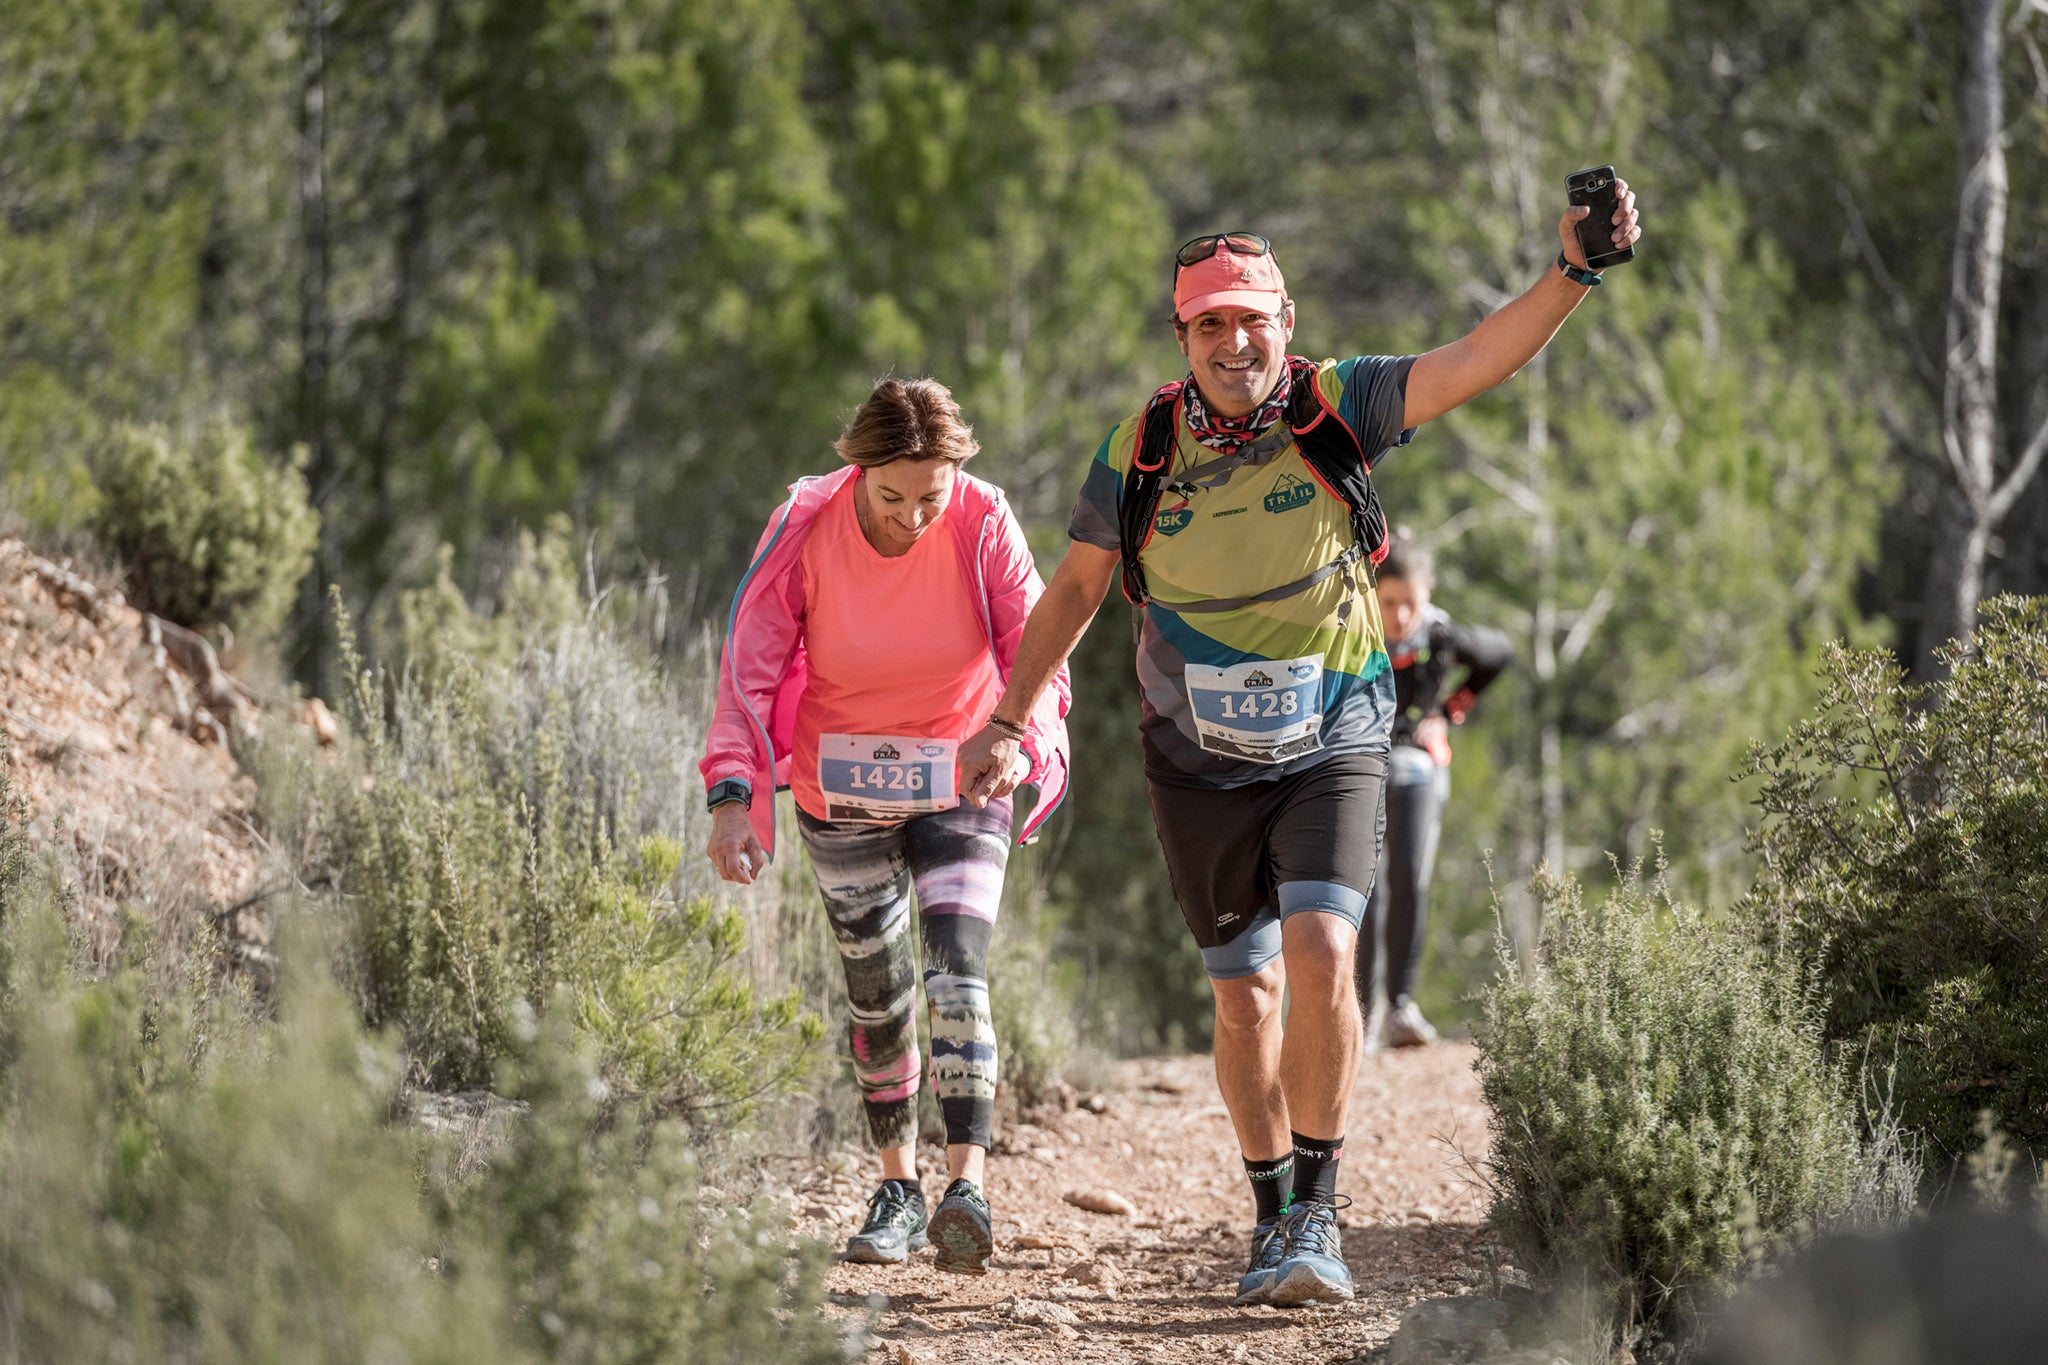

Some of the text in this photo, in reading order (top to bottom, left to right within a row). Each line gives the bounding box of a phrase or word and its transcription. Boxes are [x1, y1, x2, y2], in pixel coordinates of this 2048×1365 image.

[1267, 487, 1313, 507] TRAIL
[1156, 513, 1183, 527] 15K
[1246, 679, 1272, 687] TRAIL
[1220, 690, 1298, 719] 1428
[849, 765, 924, 791] 1426
